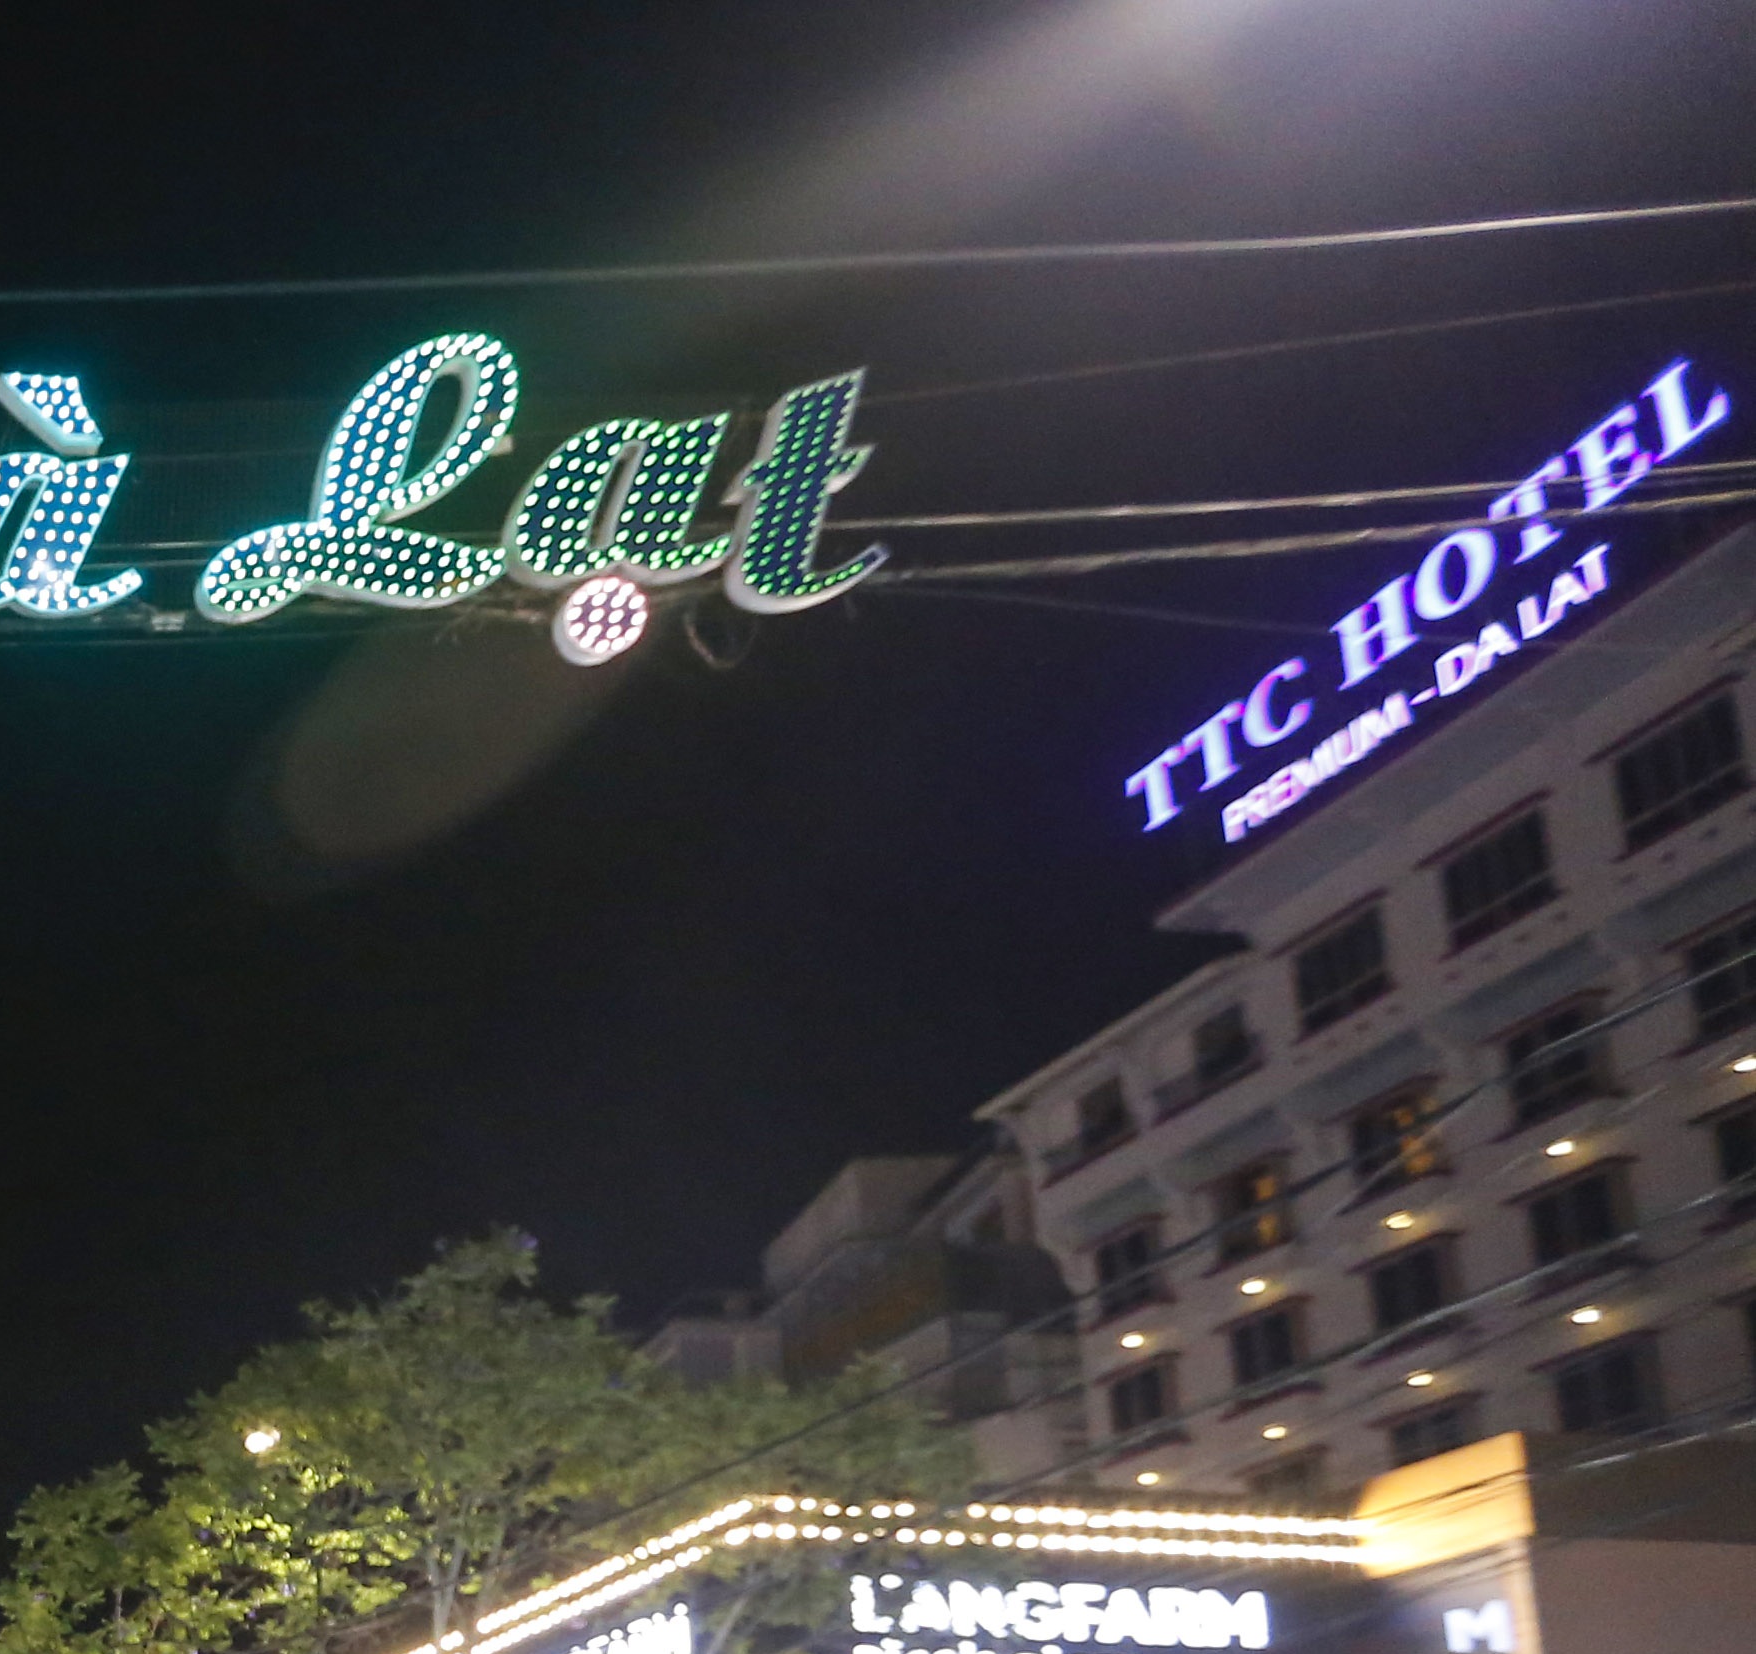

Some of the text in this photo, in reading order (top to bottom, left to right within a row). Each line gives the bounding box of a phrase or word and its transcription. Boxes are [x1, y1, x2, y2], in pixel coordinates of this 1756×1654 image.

[192, 332, 890, 667] Lạt
[1123, 356, 1730, 833] TTC HOTEL
